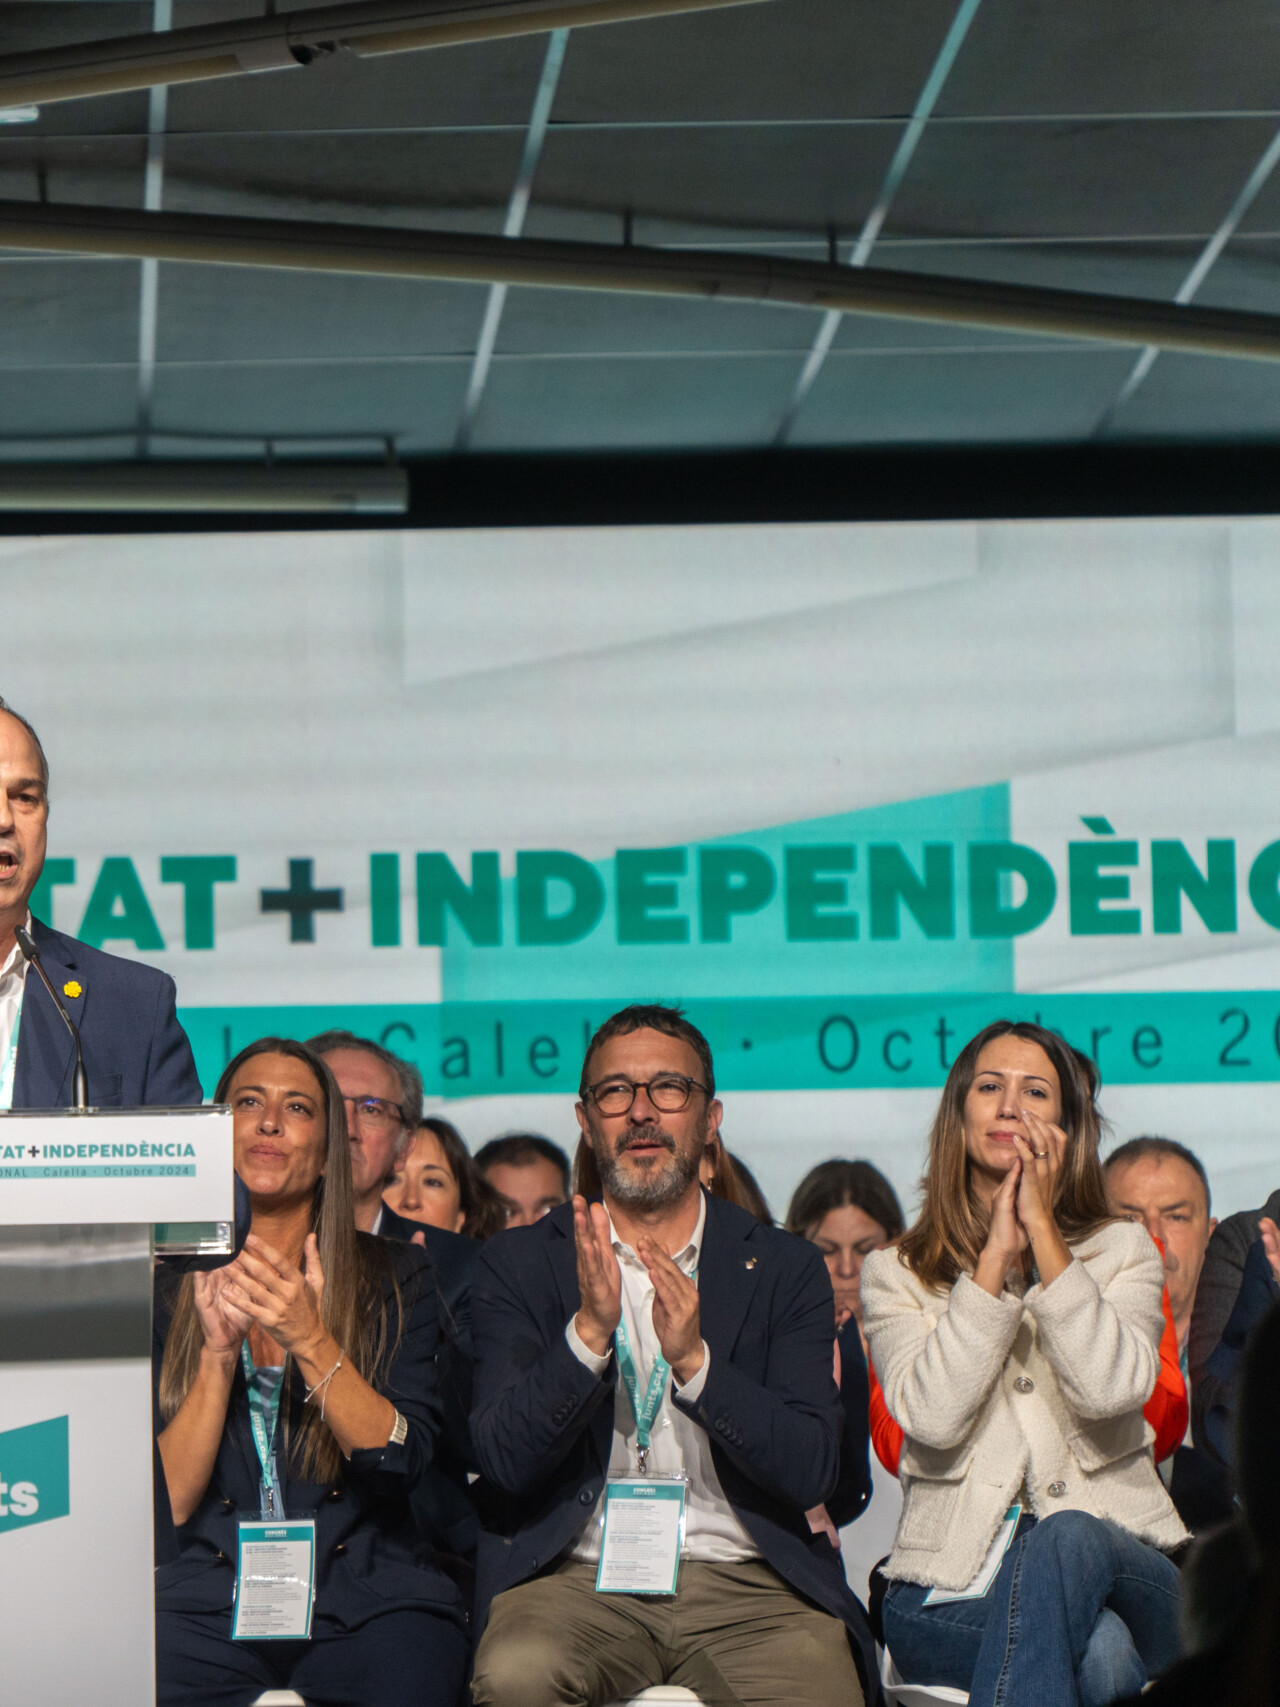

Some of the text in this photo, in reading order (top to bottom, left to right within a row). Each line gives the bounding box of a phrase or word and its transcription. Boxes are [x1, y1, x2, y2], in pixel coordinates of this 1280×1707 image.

[43, 1140, 196, 1159] INDEPENDÈNCIA
[43, 1166, 87, 1177] Calella
[104, 1165, 153, 1177] Octubre
[159, 1165, 190, 1176] 2024
